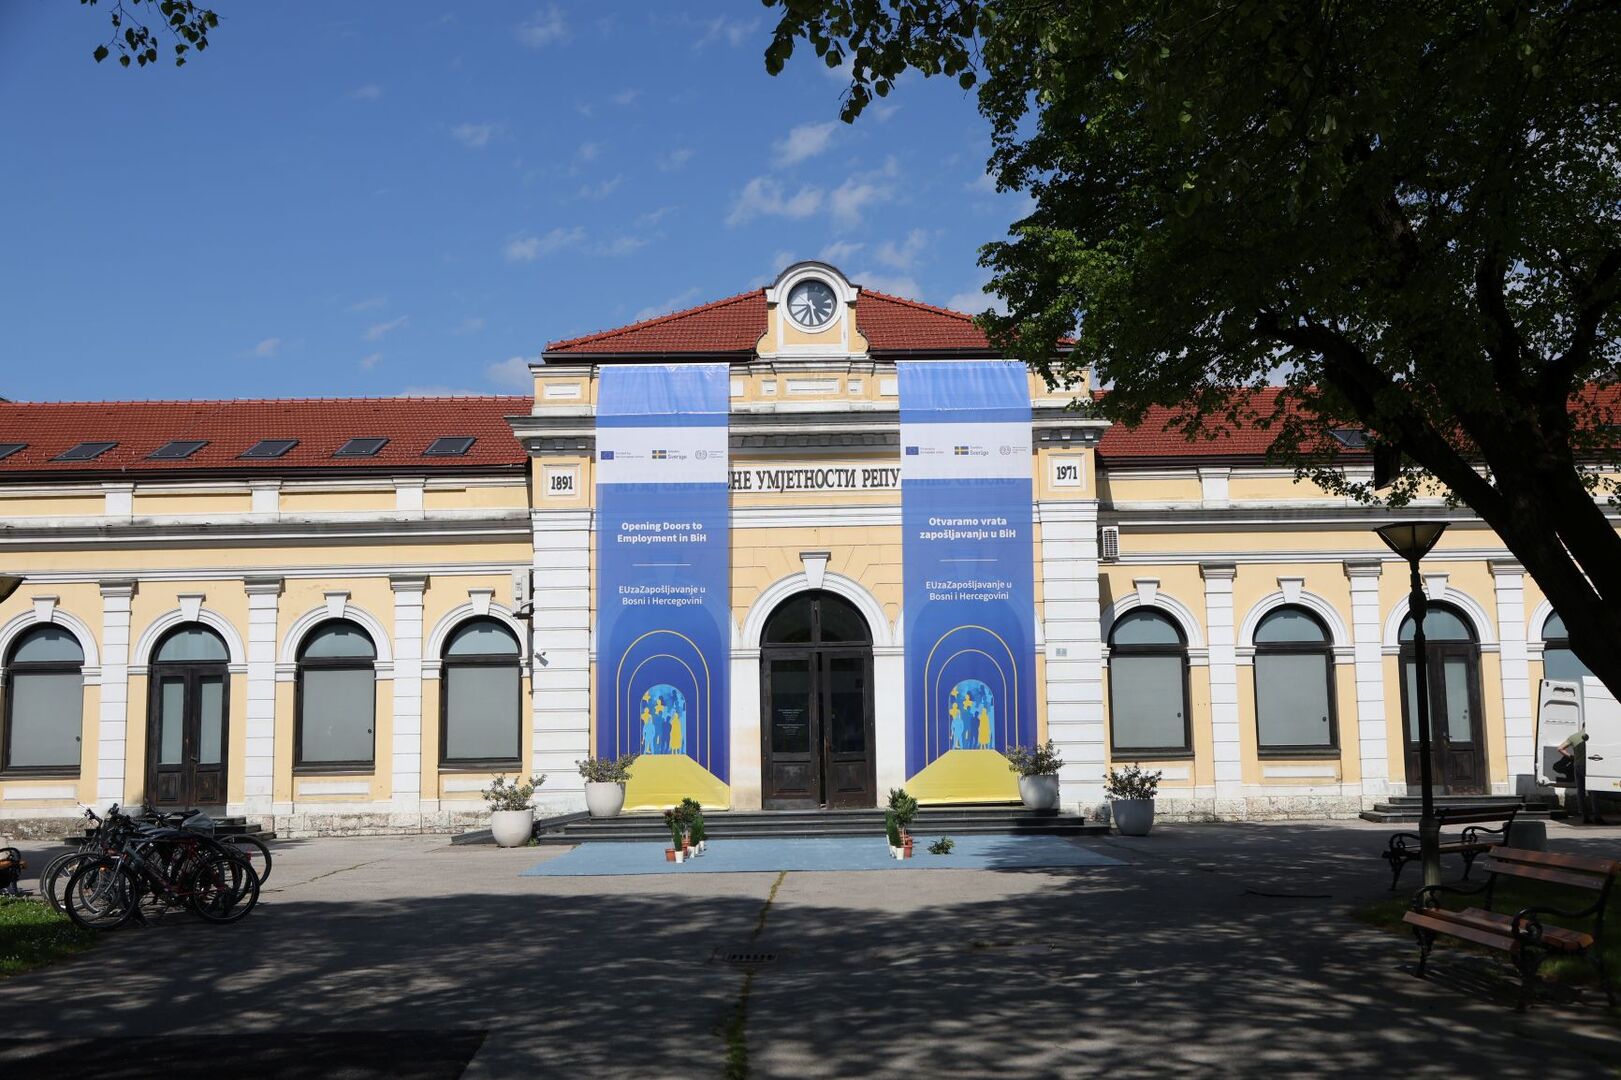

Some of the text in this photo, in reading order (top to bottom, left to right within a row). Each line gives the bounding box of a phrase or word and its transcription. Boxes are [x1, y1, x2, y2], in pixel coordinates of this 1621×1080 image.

[1056, 465, 1078, 480] 1971
[551, 476, 573, 490] 1891
[728, 471, 752, 490] НЕ
[756, 469, 857, 493] УМЈЕТНОСТИ
[861, 468, 901, 488] РЕПУ
[621, 521, 703, 532] Opening Doors to
[928, 517, 1007, 526] Otvaramo vrata
[617, 533, 707, 544] Employment in BiH
[919, 529, 1016, 540] zapošljavanju u BiH
[618, 585, 698, 595] EUzaZapošljavanje
[925, 580, 1005, 591] EUzaZapošljavanje
[622, 596, 703, 607] Bosni i Hercegovini
[929, 591, 1009, 602] Bosni i Hercegovini
